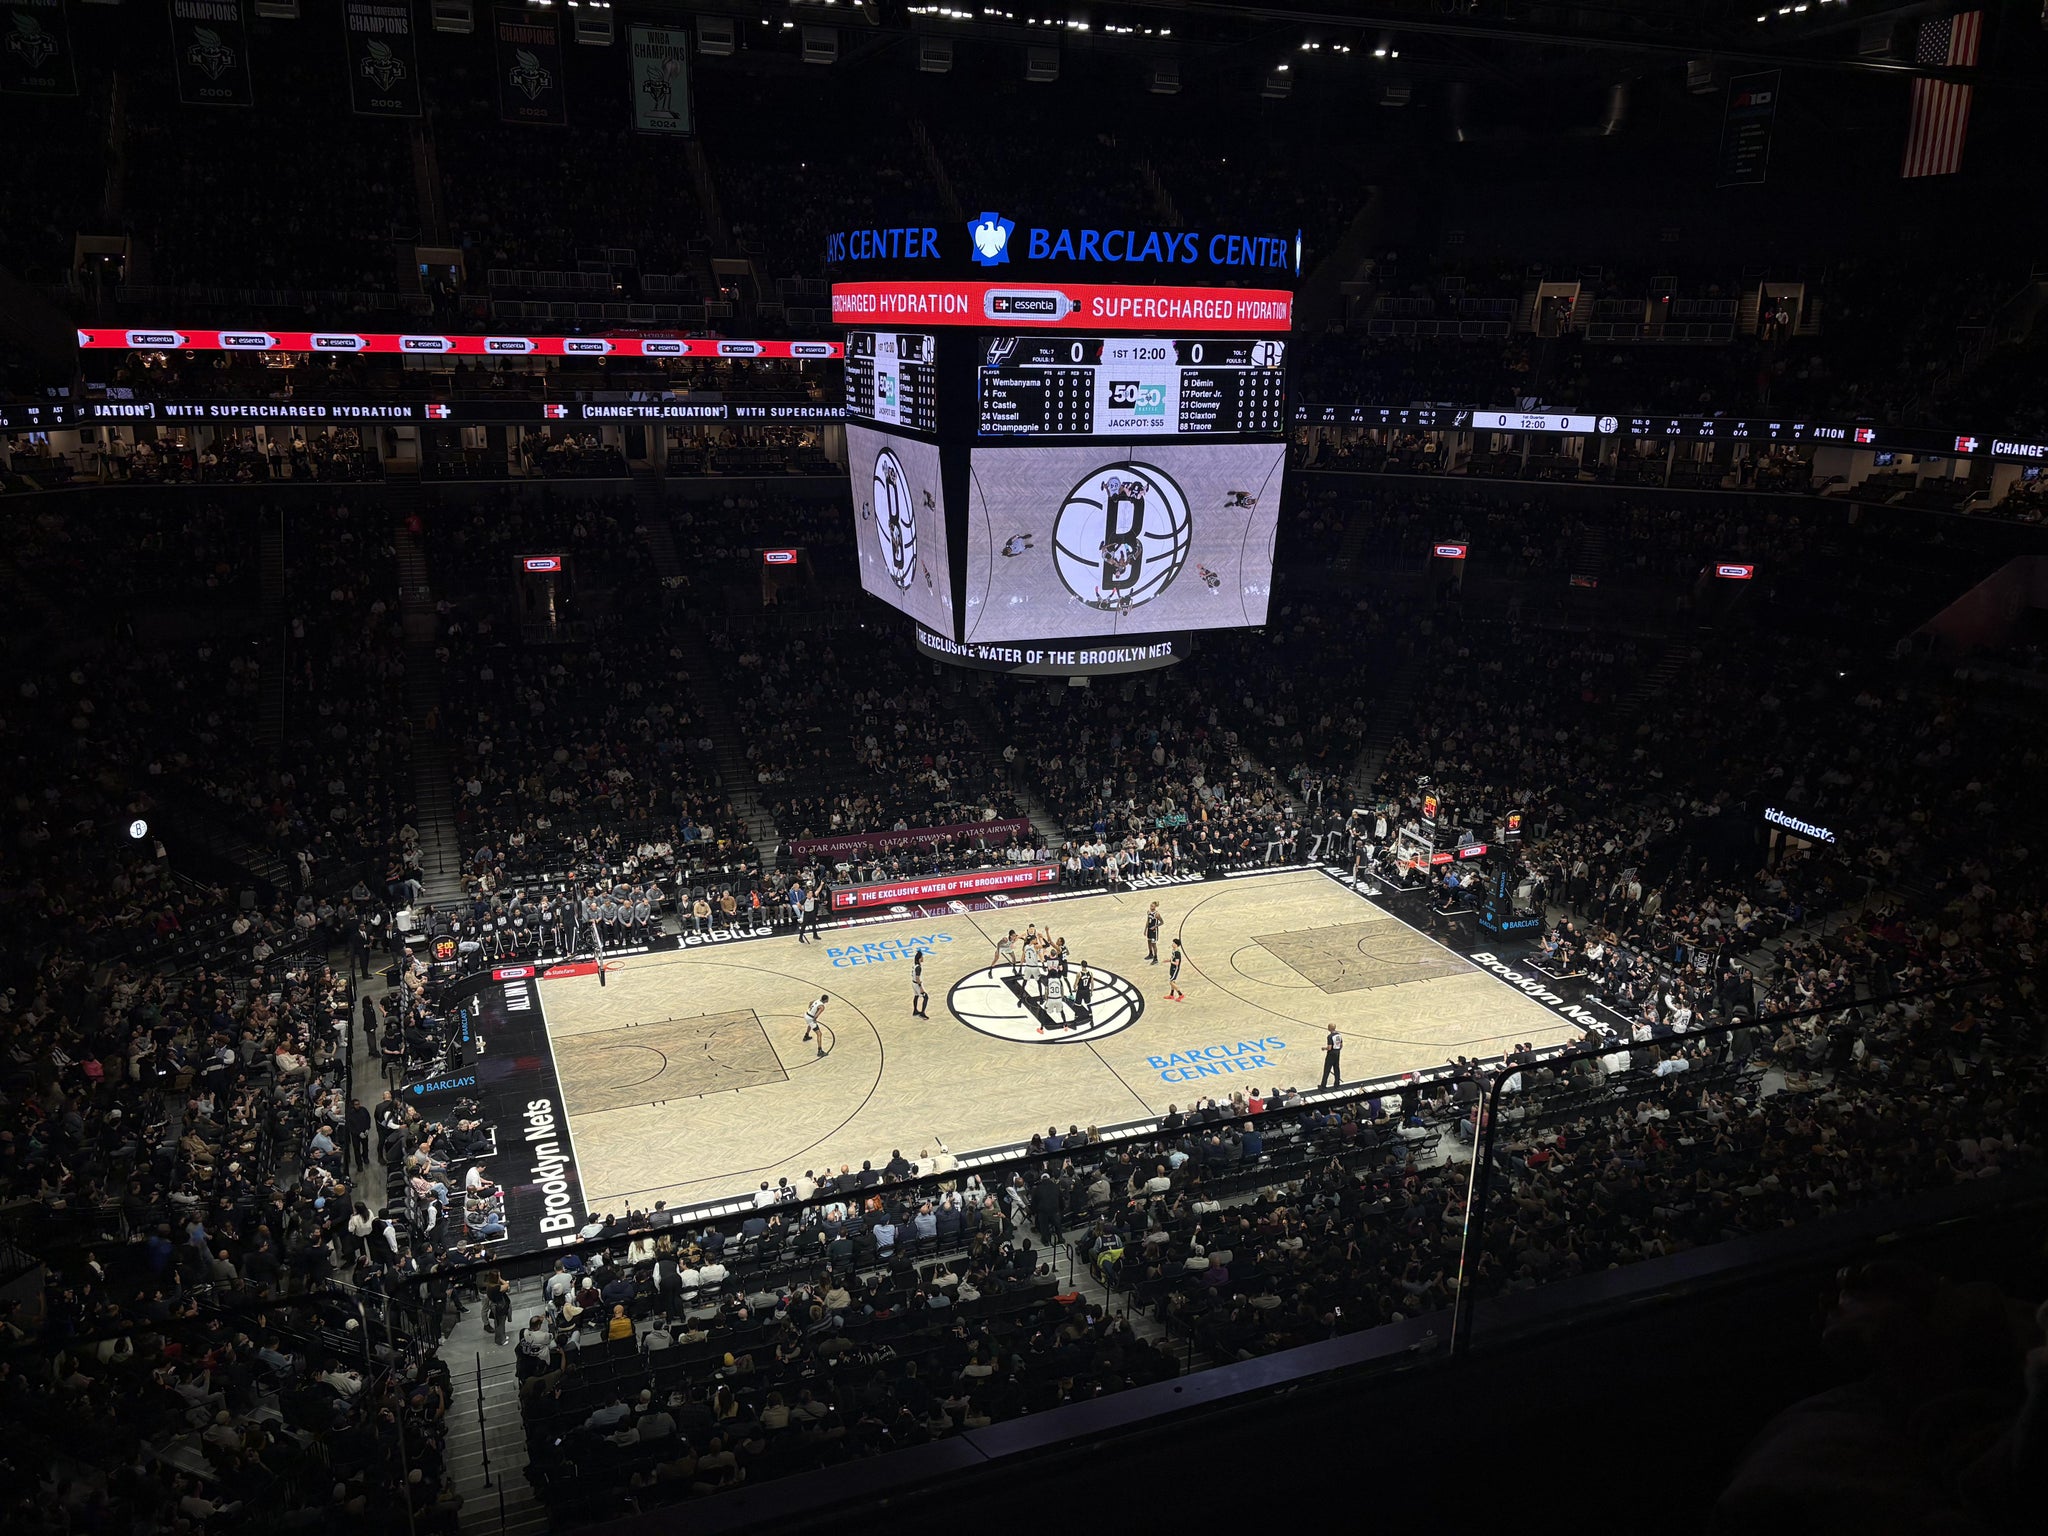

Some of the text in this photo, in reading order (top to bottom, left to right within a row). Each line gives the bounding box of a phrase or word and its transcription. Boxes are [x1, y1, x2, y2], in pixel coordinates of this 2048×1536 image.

[175, 1, 238, 22] CHAMPIONS
[350, 16, 408, 34] CHAMPIONS
[500, 23, 557, 46] CHAMPIONS
[647, 31, 670, 44] WNBA
[634, 43, 685, 61] CHAMPIONS
[199, 87, 233, 97] 2000
[370, 99, 402, 108] 2002
[650, 120, 677, 128] 2024
[850, 228, 941, 260] CENTER
[1028, 228, 1288, 269] BARCLAYS CENTER
[880, 294, 968, 314] HYDRATION
[1014, 300, 1054, 310] essentia
[1092, 296, 1287, 320] SUPERCHARGED HYDRATION
[1071, 342, 1084, 363] 0
[1112, 347, 1166, 360] 1ST 12:00
[1191, 343, 1203, 363] 0
[985, 378, 988, 386] 1
[992, 378, 1040, 388] Wembanyama
[1114, 385, 1138, 402] 50
[1137, 389, 1161, 407] 50
[1191, 390, 1211, 398] Porter
[1213, 390, 1222, 398] Jr.
[165, 405, 204, 416] WITH
[211, 406, 326, 417] SUPERCHARGED
[333, 407, 412, 417] HYDRATION
[736, 407, 766, 417] WITH
[992, 424, 1039, 432] Champagnie
[1108, 419, 1149, 428] JACKPOT:
[1499, 415, 1507, 427] 0
[1521, 420, 1545, 429] 12:00
[1561, 417, 1569, 429] 0
[1814, 428, 1845, 439] ATION
[979, 645, 1022, 663] WATER
[1026, 650, 1043, 664] OF
[1049, 651, 1075, 665] THE
[1080, 648, 1146, 665] BROOKLYN
[1149, 641, 1172, 658] NETS
[956, 823, 1021, 838] QTAR AIRWAYS
[798, 840, 868, 855] QTAR AIRWAYS
[861, 873, 1033, 901] THE EXCLUSIVE WATER OF THE BROOKLYN NETS
[1509, 919, 1539, 929] BARCLAYS
[676, 925, 773, 949] jetBlue
[826, 932, 953, 958] BARCLAYS
[438, 949, 451, 958] 24
[832, 946, 937, 968] CENTER
[1050, 986, 1059, 994] 30
[1470, 952, 1618, 1036] Brooklyn Nets
[506, 996, 531, 1011] ALL
[460, 1009, 469, 1035] BARCLAYS
[1146, 1036, 1286, 1070] BARCLAYS
[1160, 1055, 1277, 1083] CENTER
[426, 1076, 476, 1092] BARCLAYS
[522, 1098, 576, 1233] Brooklyn Nets
